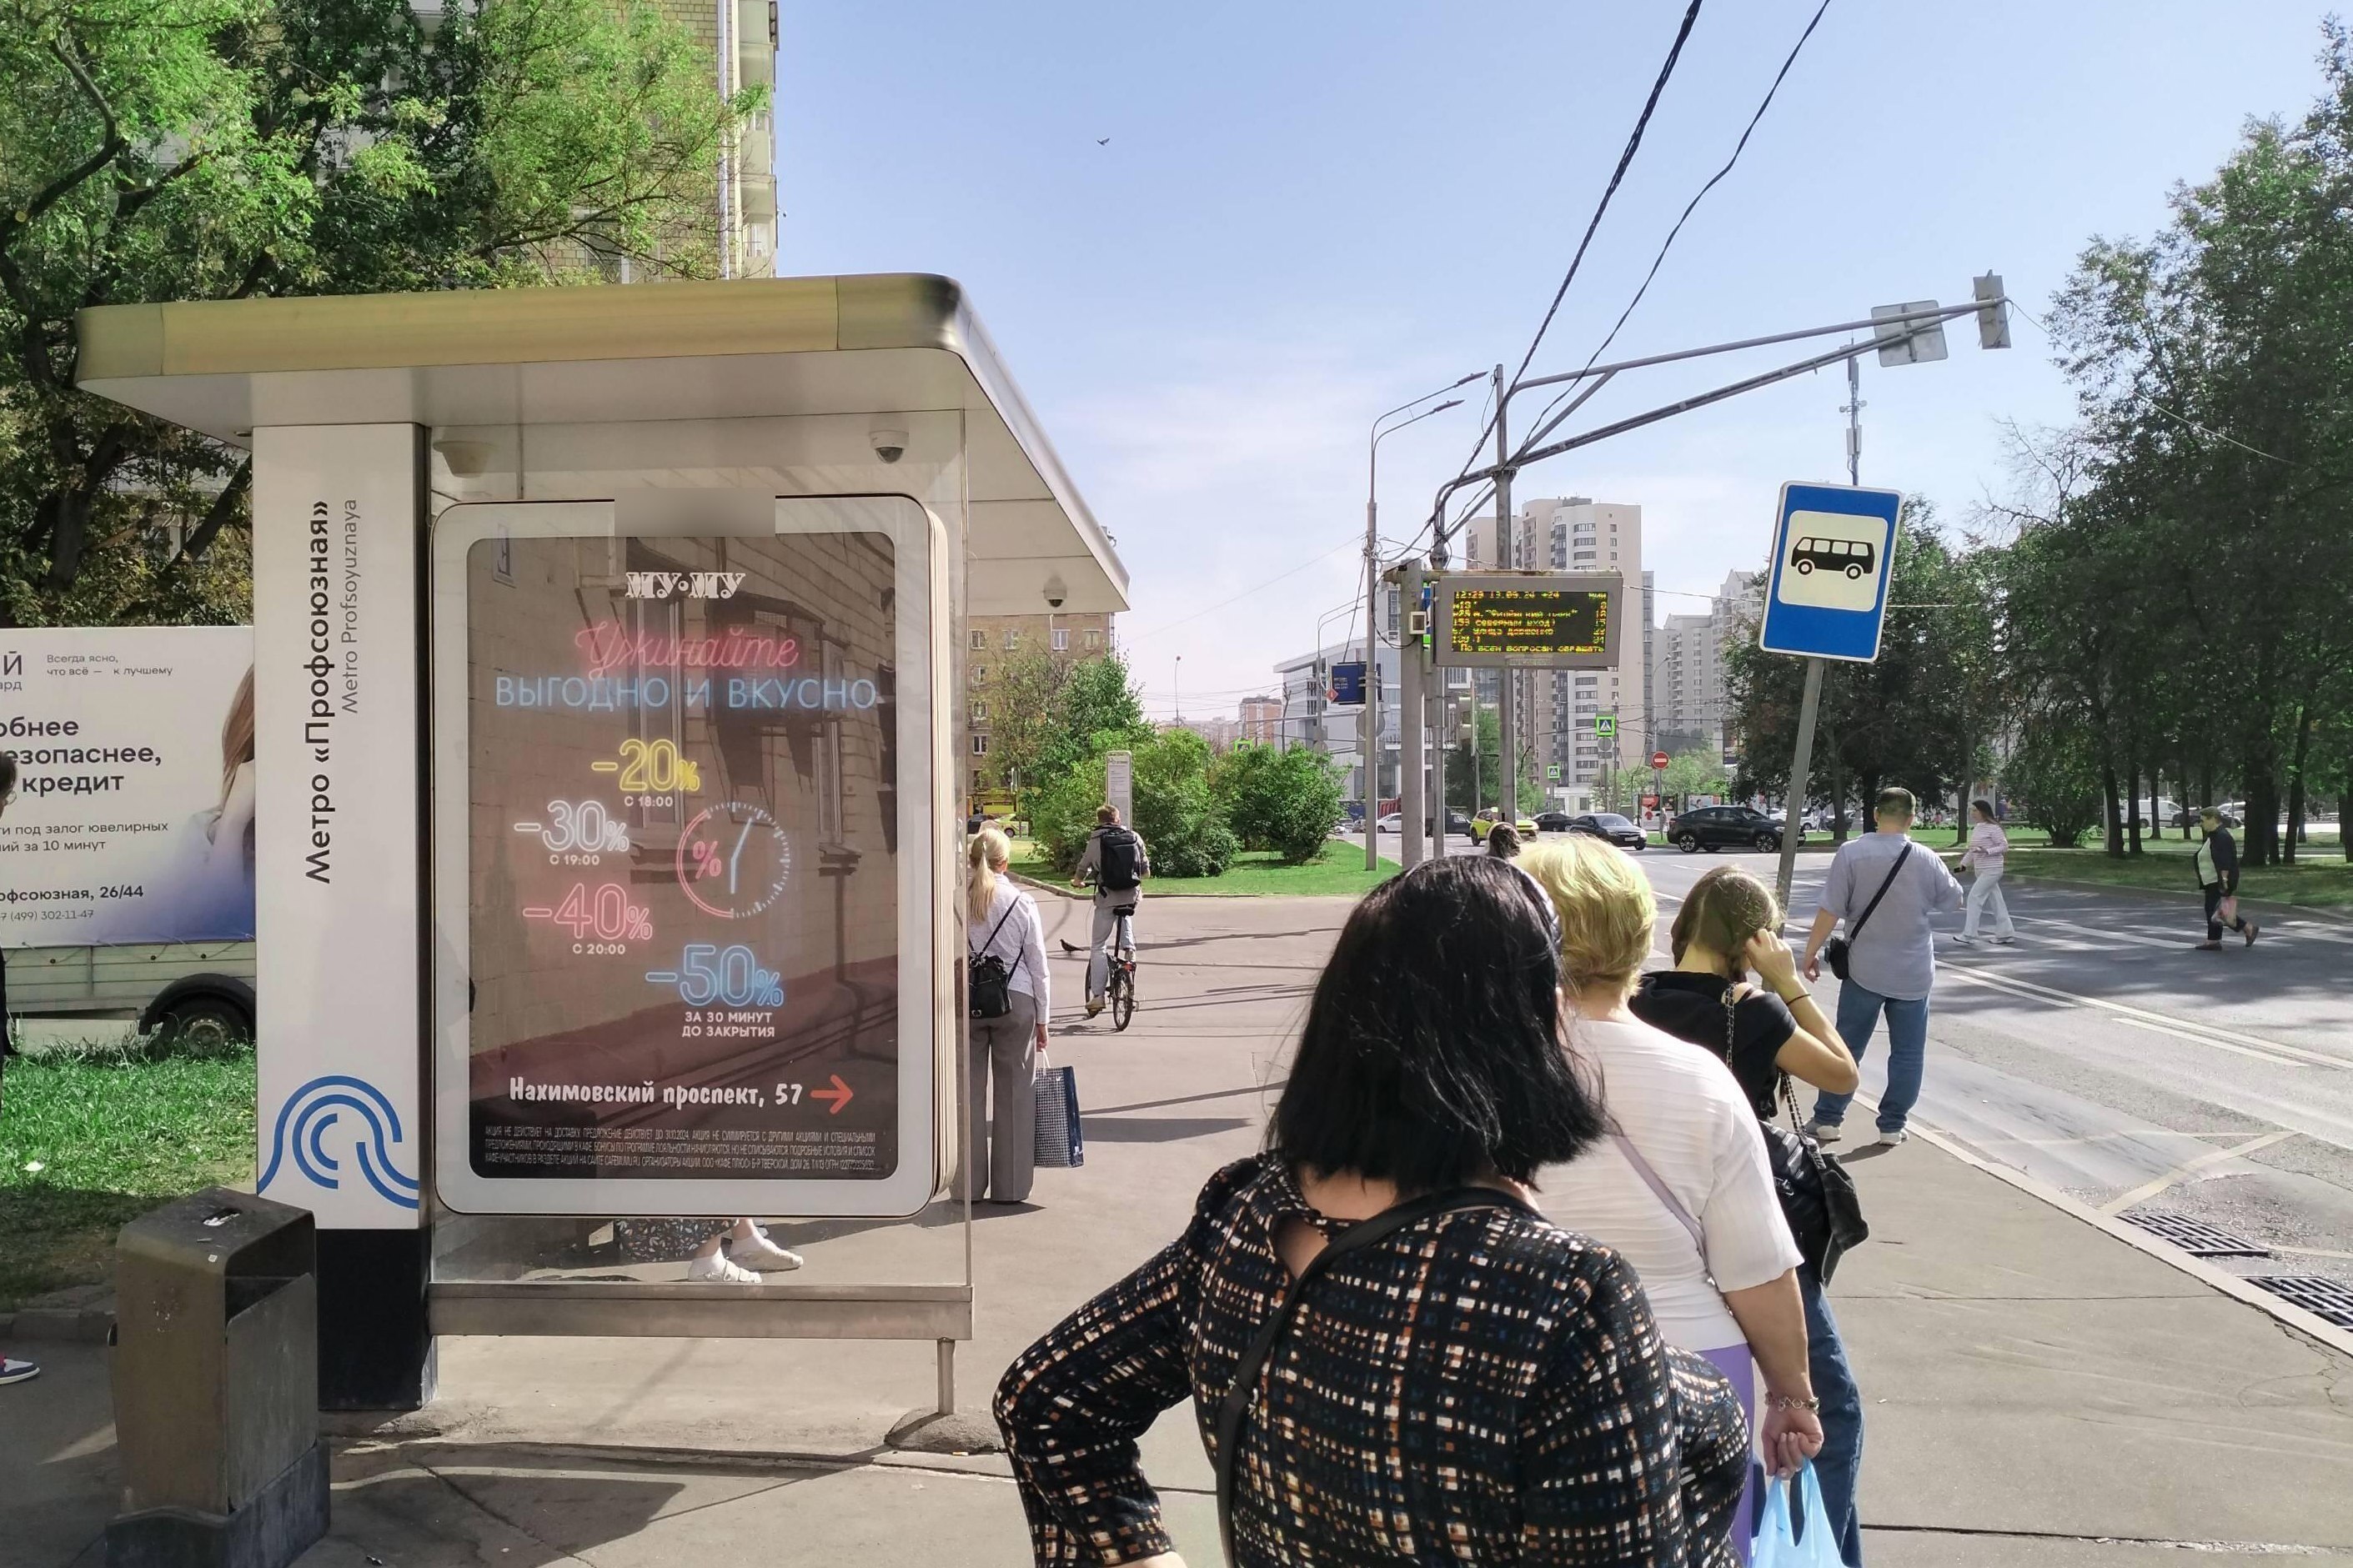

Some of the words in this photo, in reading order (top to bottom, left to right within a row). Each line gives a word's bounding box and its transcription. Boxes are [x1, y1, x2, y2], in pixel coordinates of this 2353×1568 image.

[340, 499, 361, 644] Profsoyuznaya
[304, 500, 335, 763] «Профсоюзная»
[574, 621, 800, 680] Ужинайте
[47, 654, 85, 664] Всегда
[89, 655, 119, 664] ясно,
[47, 668, 67, 676] что
[69, 665, 89, 675] всё
[123, 667, 173, 678] лучшему
[341, 649, 359, 714] Metro
[494, 676, 670, 711] ВЫГОДНО
[686, 679, 710, 708] И
[727, 678, 877, 709] ВКУСНО
[23, 775, 124, 797] кредит
[638, 796, 674, 807] 18:00
[15, 825, 42, 836] под
[45, 824, 84, 834] залог
[88, 823, 168, 836] ювелирных
[305, 774, 335, 884] Метро
[23, 843, 38, 852] за
[43, 840, 59, 851] 10
[63, 840, 107, 852] минут
[564, 854, 600, 866] 19:00
[99, 884, 144, 899] 26/44
[10, 911, 38, 922] (499)
[41, 909, 94, 920] 302-11-47
[587, 944, 626, 955] 20:00
[685, 1012, 703, 1023] ЗА
[707, 1012, 725, 1023] 30
[728, 1012, 773, 1024] МИНУТ
[681, 1026, 703, 1039] ДО
[707, 1026, 775, 1038] ЗАКРЫТИЯ
[509, 1077, 655, 1104] Нахимовский
[663, 1085, 765, 1110] проспект,
[775, 1084, 804, 1105] 57
